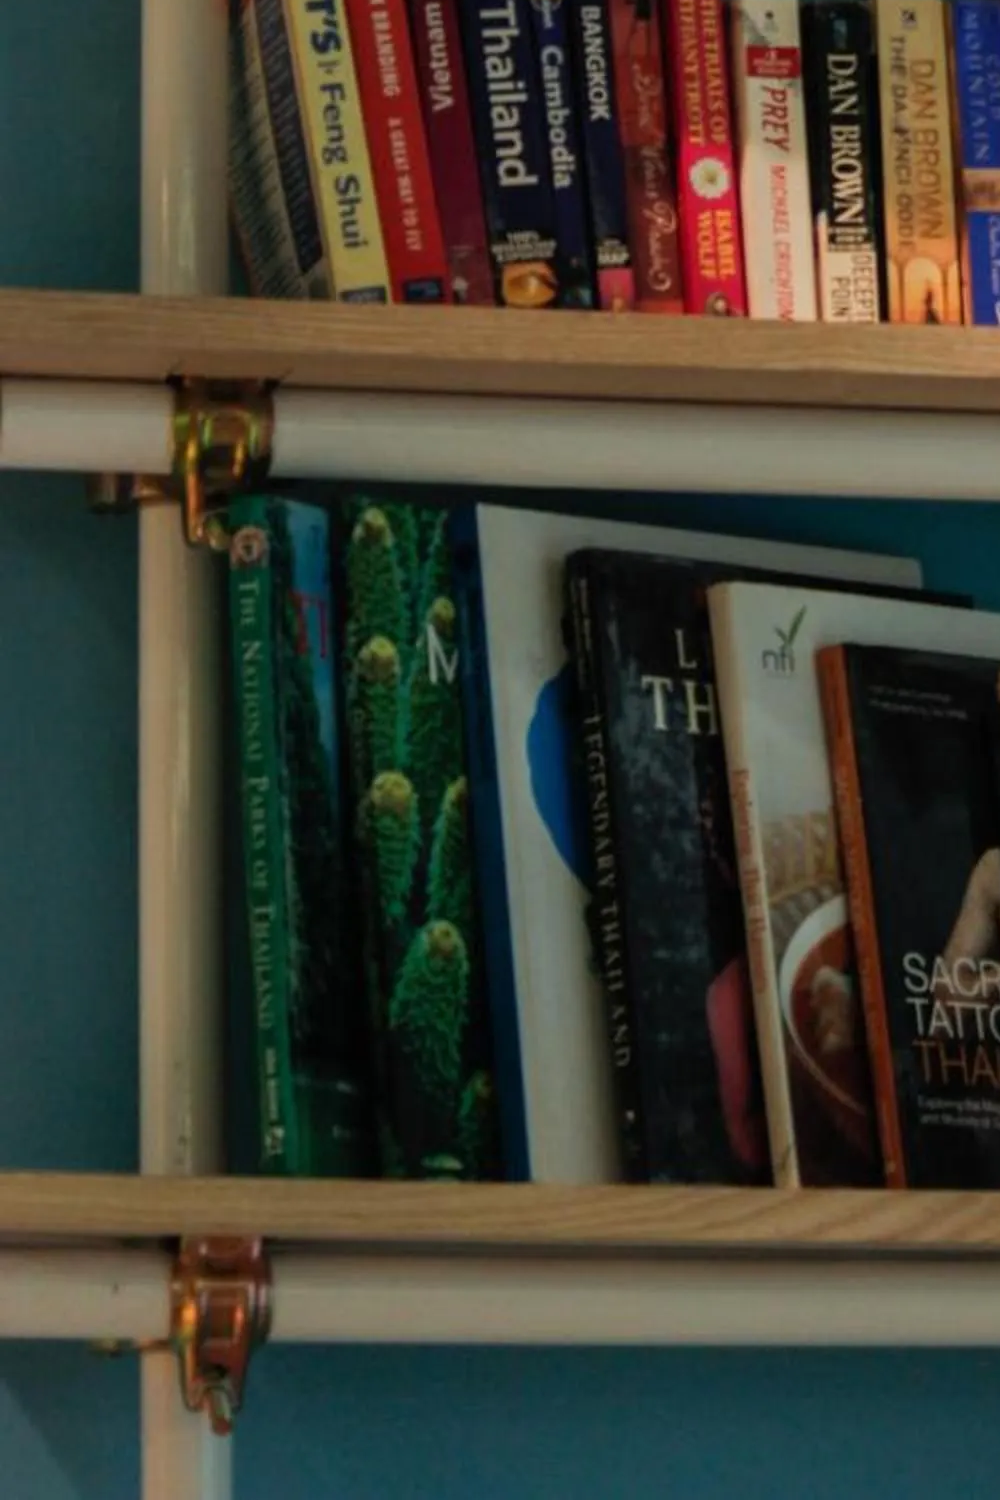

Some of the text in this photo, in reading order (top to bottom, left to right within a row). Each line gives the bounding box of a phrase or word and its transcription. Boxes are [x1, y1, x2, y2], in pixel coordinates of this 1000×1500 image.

[370, 10, 402, 98] BRANDING
[425, 2, 455, 113] Vietnam
[479, 0, 539, 189] Thailand
[581, 5, 614, 122] BANGKOK
[703, 42, 724, 112] TRIALS
[827, 53, 859, 115] DAN
[891, 36, 906, 77] THE
[961, 9, 991, 161] MOUNTAIN
[318, 82, 349, 166] Feng
[540, 45, 578, 190] Cambodia
[709, 114, 728, 145] OF
[761, 84, 790, 153] PREY
[893, 84, 907, 113] DA
[830, 124, 864, 224] BROWN
[909, 59, 944, 239] DAN BROWN
[333, 175, 369, 250] Shui
[831, 276, 851, 318] POIN
[852, 254, 875, 321] DECEPT
[583, 708, 617, 889] LEGENDARY
[600, 899, 632, 1068] THAILAND
